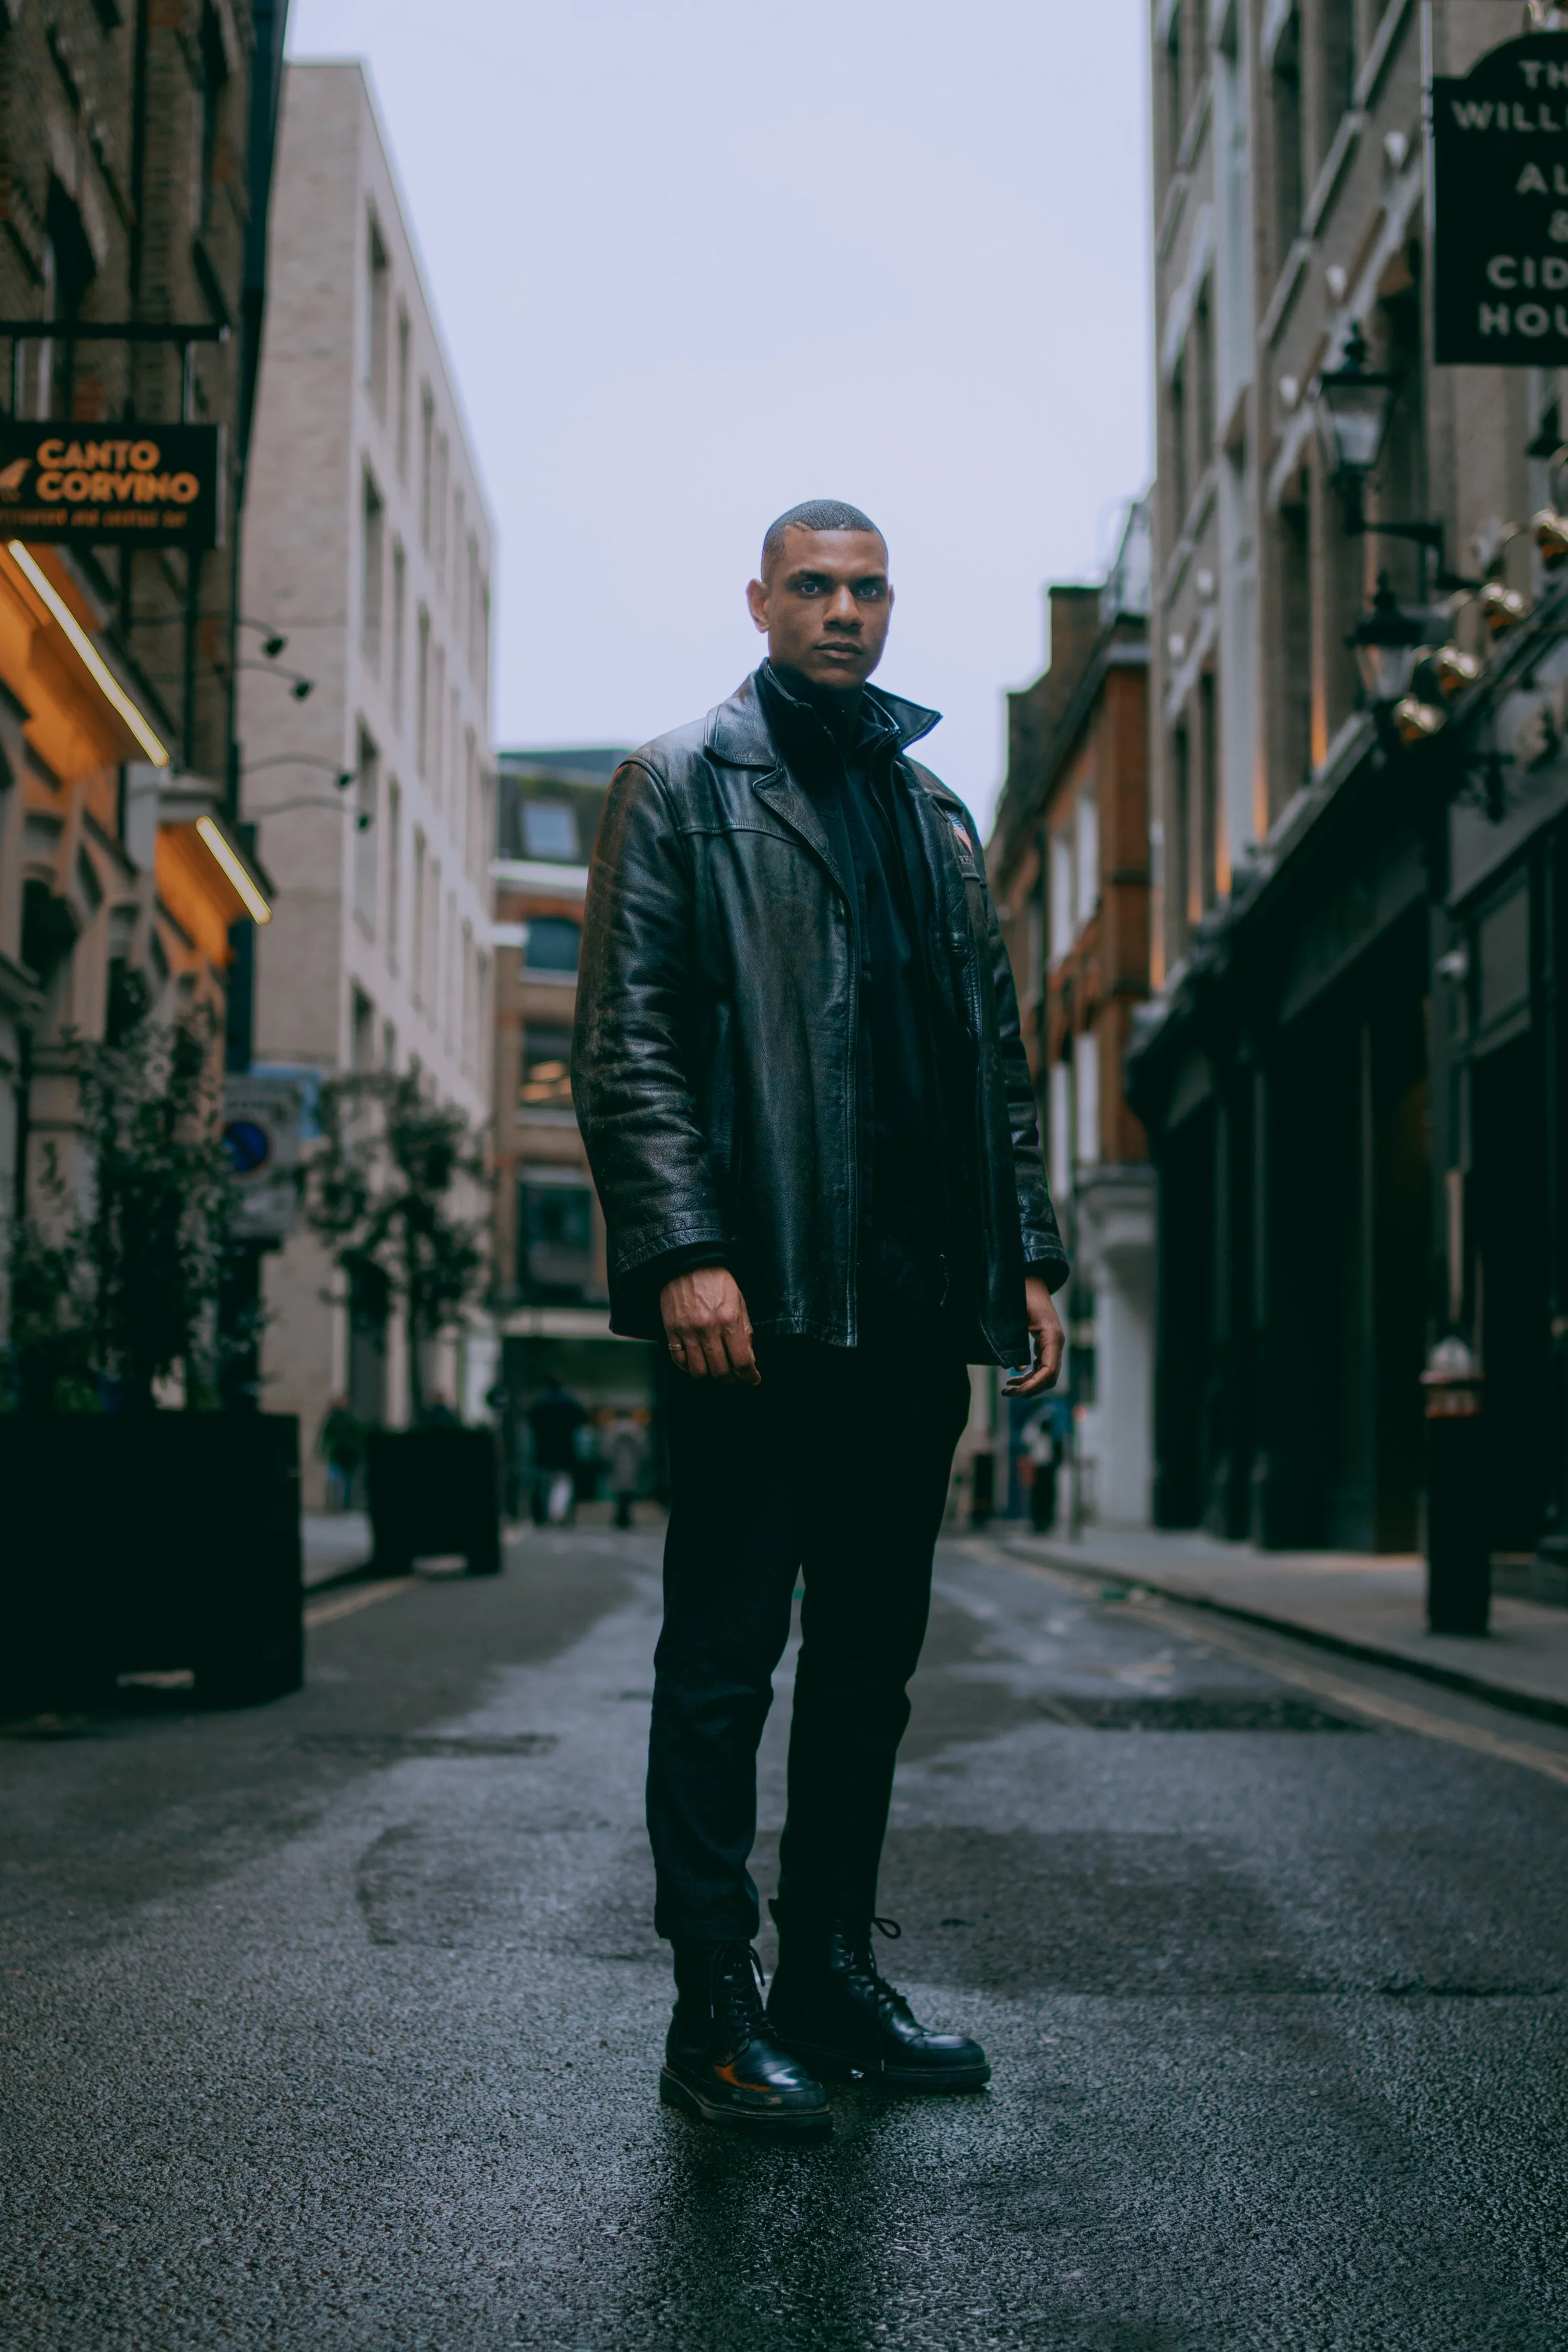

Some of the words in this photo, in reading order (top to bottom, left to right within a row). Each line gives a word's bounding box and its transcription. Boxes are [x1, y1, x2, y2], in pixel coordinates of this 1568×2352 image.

[1451, 100, 1568, 132] WILL
[1486, 254, 1568, 290] CID
[37, 438, 160, 471] CANTO
[36, 471, 199, 504] CORVINO
